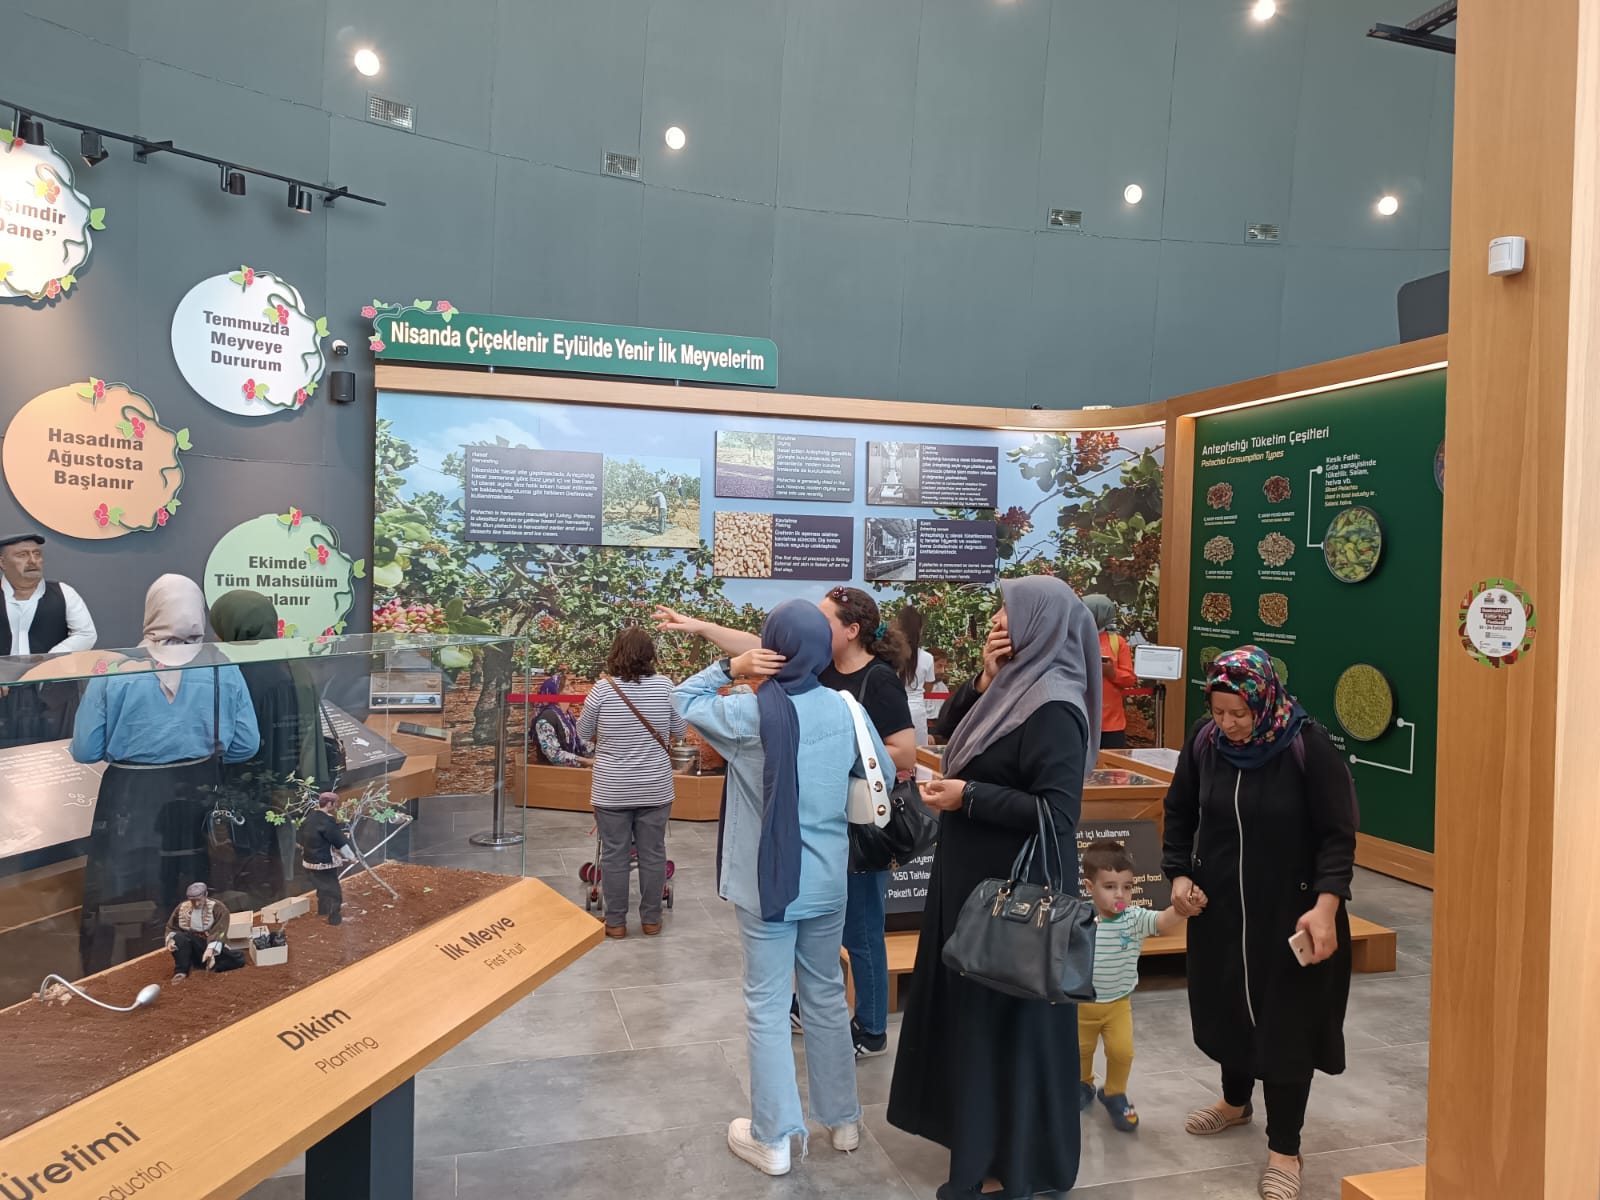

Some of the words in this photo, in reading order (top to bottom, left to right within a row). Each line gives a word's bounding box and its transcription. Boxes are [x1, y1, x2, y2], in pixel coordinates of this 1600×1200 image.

[203, 310, 289, 336] Temmuzda
[211, 331, 282, 354] Meyveye
[391, 321, 461, 347] Nisanda
[465, 326, 549, 355] Çiçeklenir
[553, 333, 613, 361] Eylülde
[614, 338, 655, 363] Yenir
[658, 337, 677, 363] İlk
[681, 344, 765, 371] Meyvelerim
[211, 350, 282, 372] Dururum
[48, 427, 143, 451] Hasadıma
[1252, 435, 1286, 448] Tüketim
[1289, 427, 1329, 445] Çeşitleri
[47, 449, 143, 471] Ağustosta
[1201, 458, 1226, 467] Pistachio
[1226, 453, 1264, 464] Consumption
[1266, 450, 1284, 460] Types
[1340, 459, 1376, 469] sanayisinde
[54, 470, 135, 491] Başlanır
[249, 556, 307, 569] Ekimde
[214, 574, 250, 587] Tüm
[256, 574, 338, 588] Mahsülüm
[892, 871, 908, 880] %50
[1147, 873, 1161, 881] food
[888, 889, 912, 898] Paketli
[435, 943, 470, 961] İlk
[460, 917, 515, 949] Meyve
[483, 953, 507, 970] First
[502, 942, 528, 959] Fruit
[276, 1009, 352, 1051] Dikim
[314, 1036, 379, 1074] Planting
